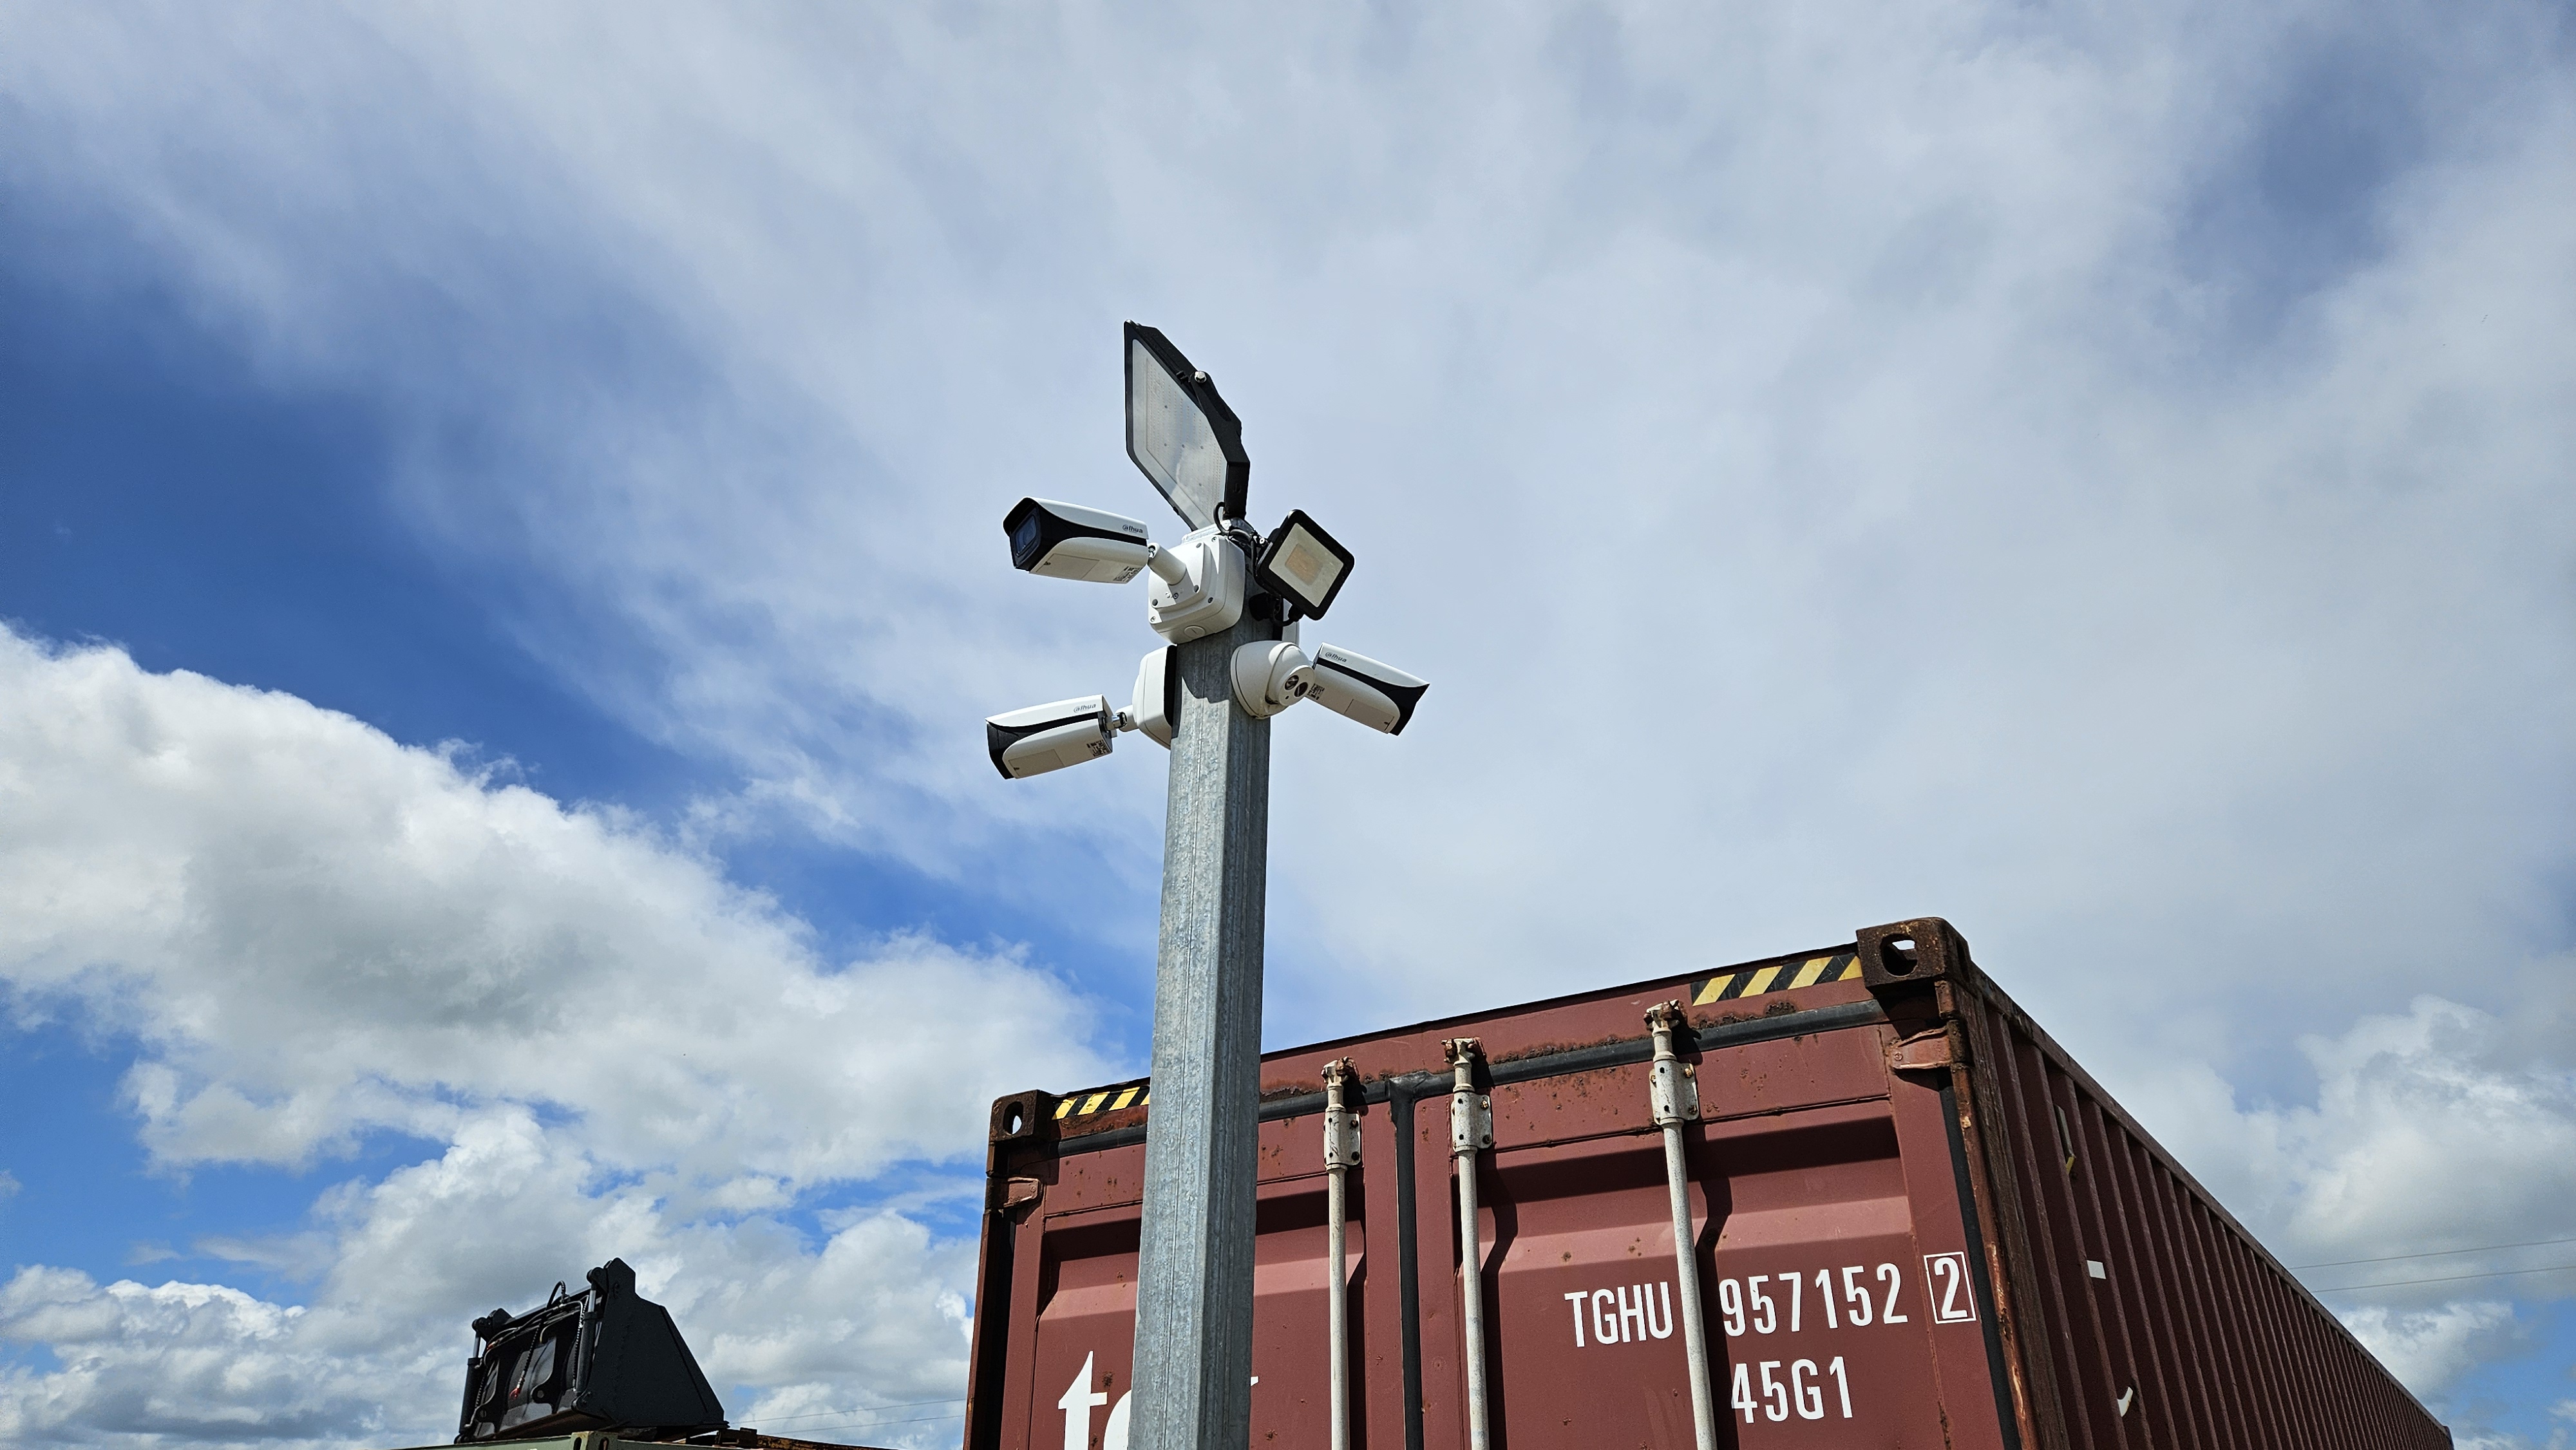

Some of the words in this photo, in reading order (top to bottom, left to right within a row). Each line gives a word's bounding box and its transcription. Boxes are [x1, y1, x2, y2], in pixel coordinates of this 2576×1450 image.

[1564, 1281, 1673, 1348] TGHU
[1719, 1263, 1908, 1337] 957152
[1933, 1256, 1969, 1320] 2
[1731, 1356, 1853, 1424] 45G1
